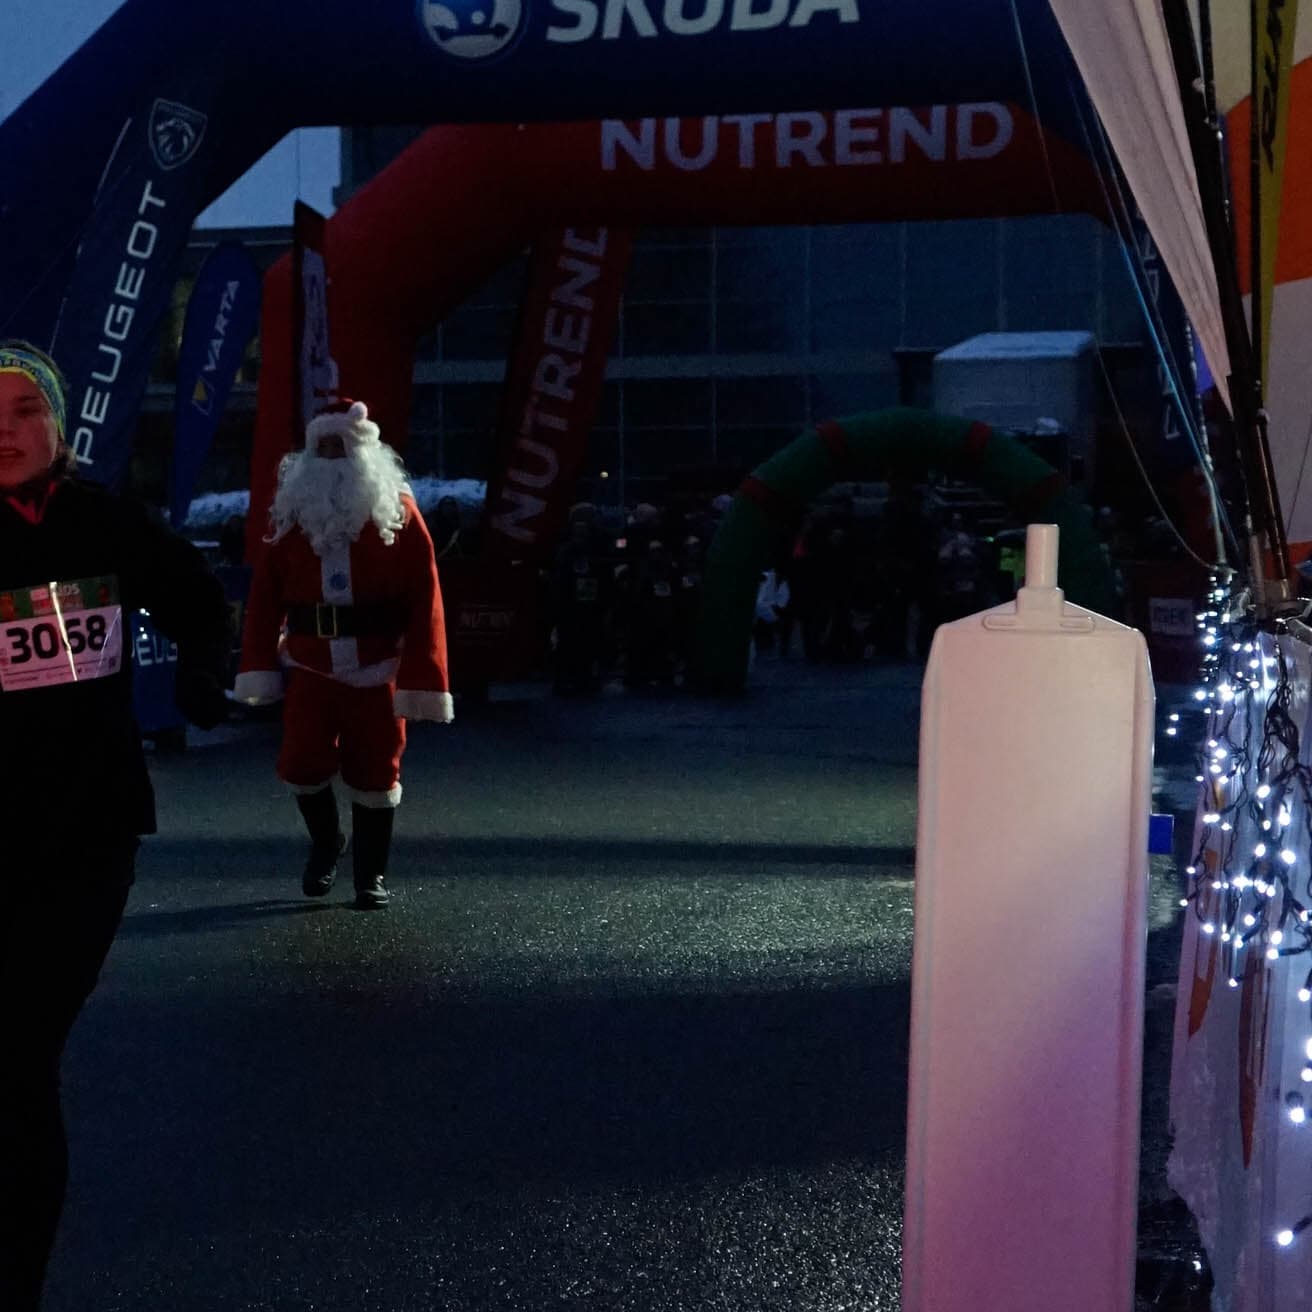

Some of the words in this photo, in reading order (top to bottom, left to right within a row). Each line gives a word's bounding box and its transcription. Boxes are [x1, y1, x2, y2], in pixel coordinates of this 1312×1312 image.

[600, 100, 1014, 172] NUTREND
[72, 179, 167, 466] PEUGEOT
[201, 280, 240, 372] VARTA
[6, 615, 107, 665] 3068
